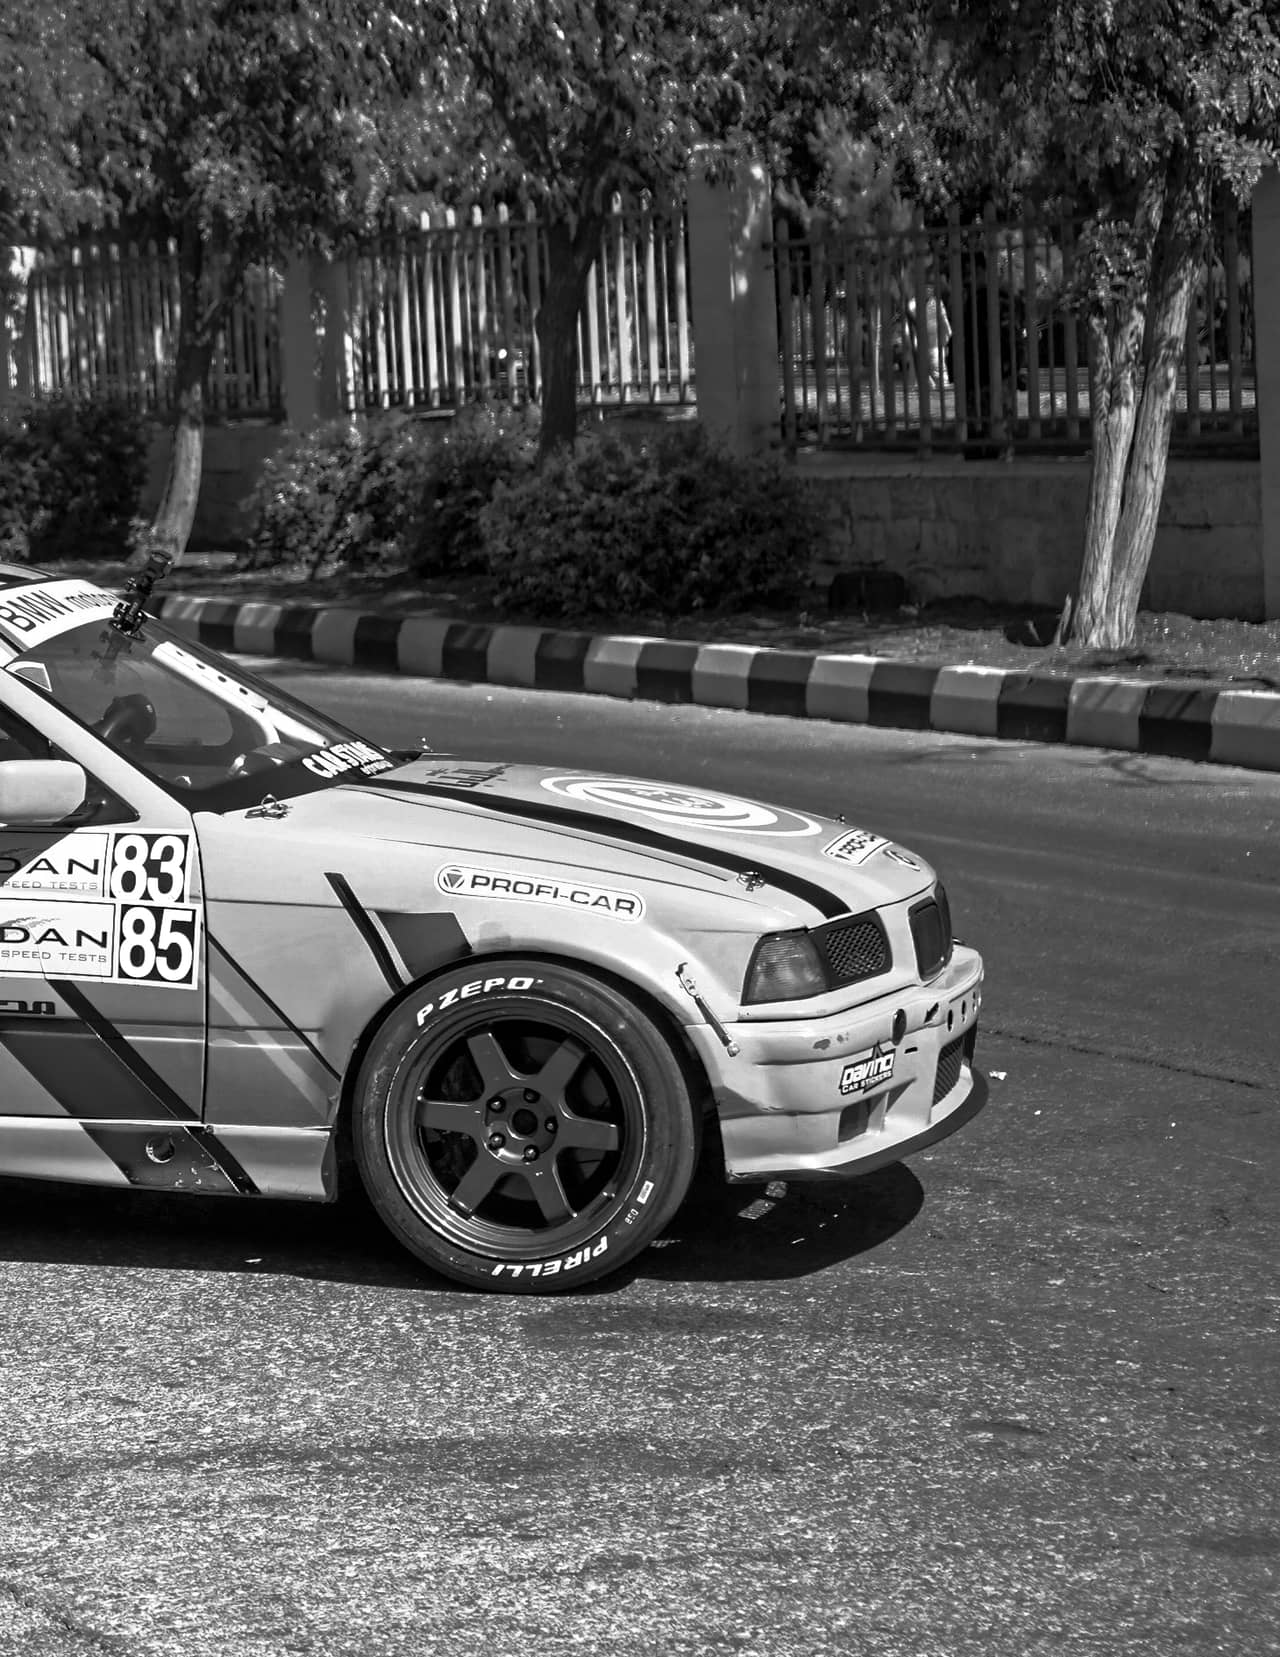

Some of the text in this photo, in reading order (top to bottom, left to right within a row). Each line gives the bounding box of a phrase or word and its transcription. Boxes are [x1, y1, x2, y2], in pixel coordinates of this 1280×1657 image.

[302, 750, 352, 778] CAR
[110, 834, 185, 903] 83
[50, 881, 98, 890] TESTS
[471, 874, 635, 914] PROFI-CAR
[1, 950, 107, 962] SPEED TESTS
[119, 906, 193, 981] 85
[416, 1003, 434, 1026] P
[842, 1083, 858, 1094] CAR
[491, 1236, 608, 1277] PIRELLI
